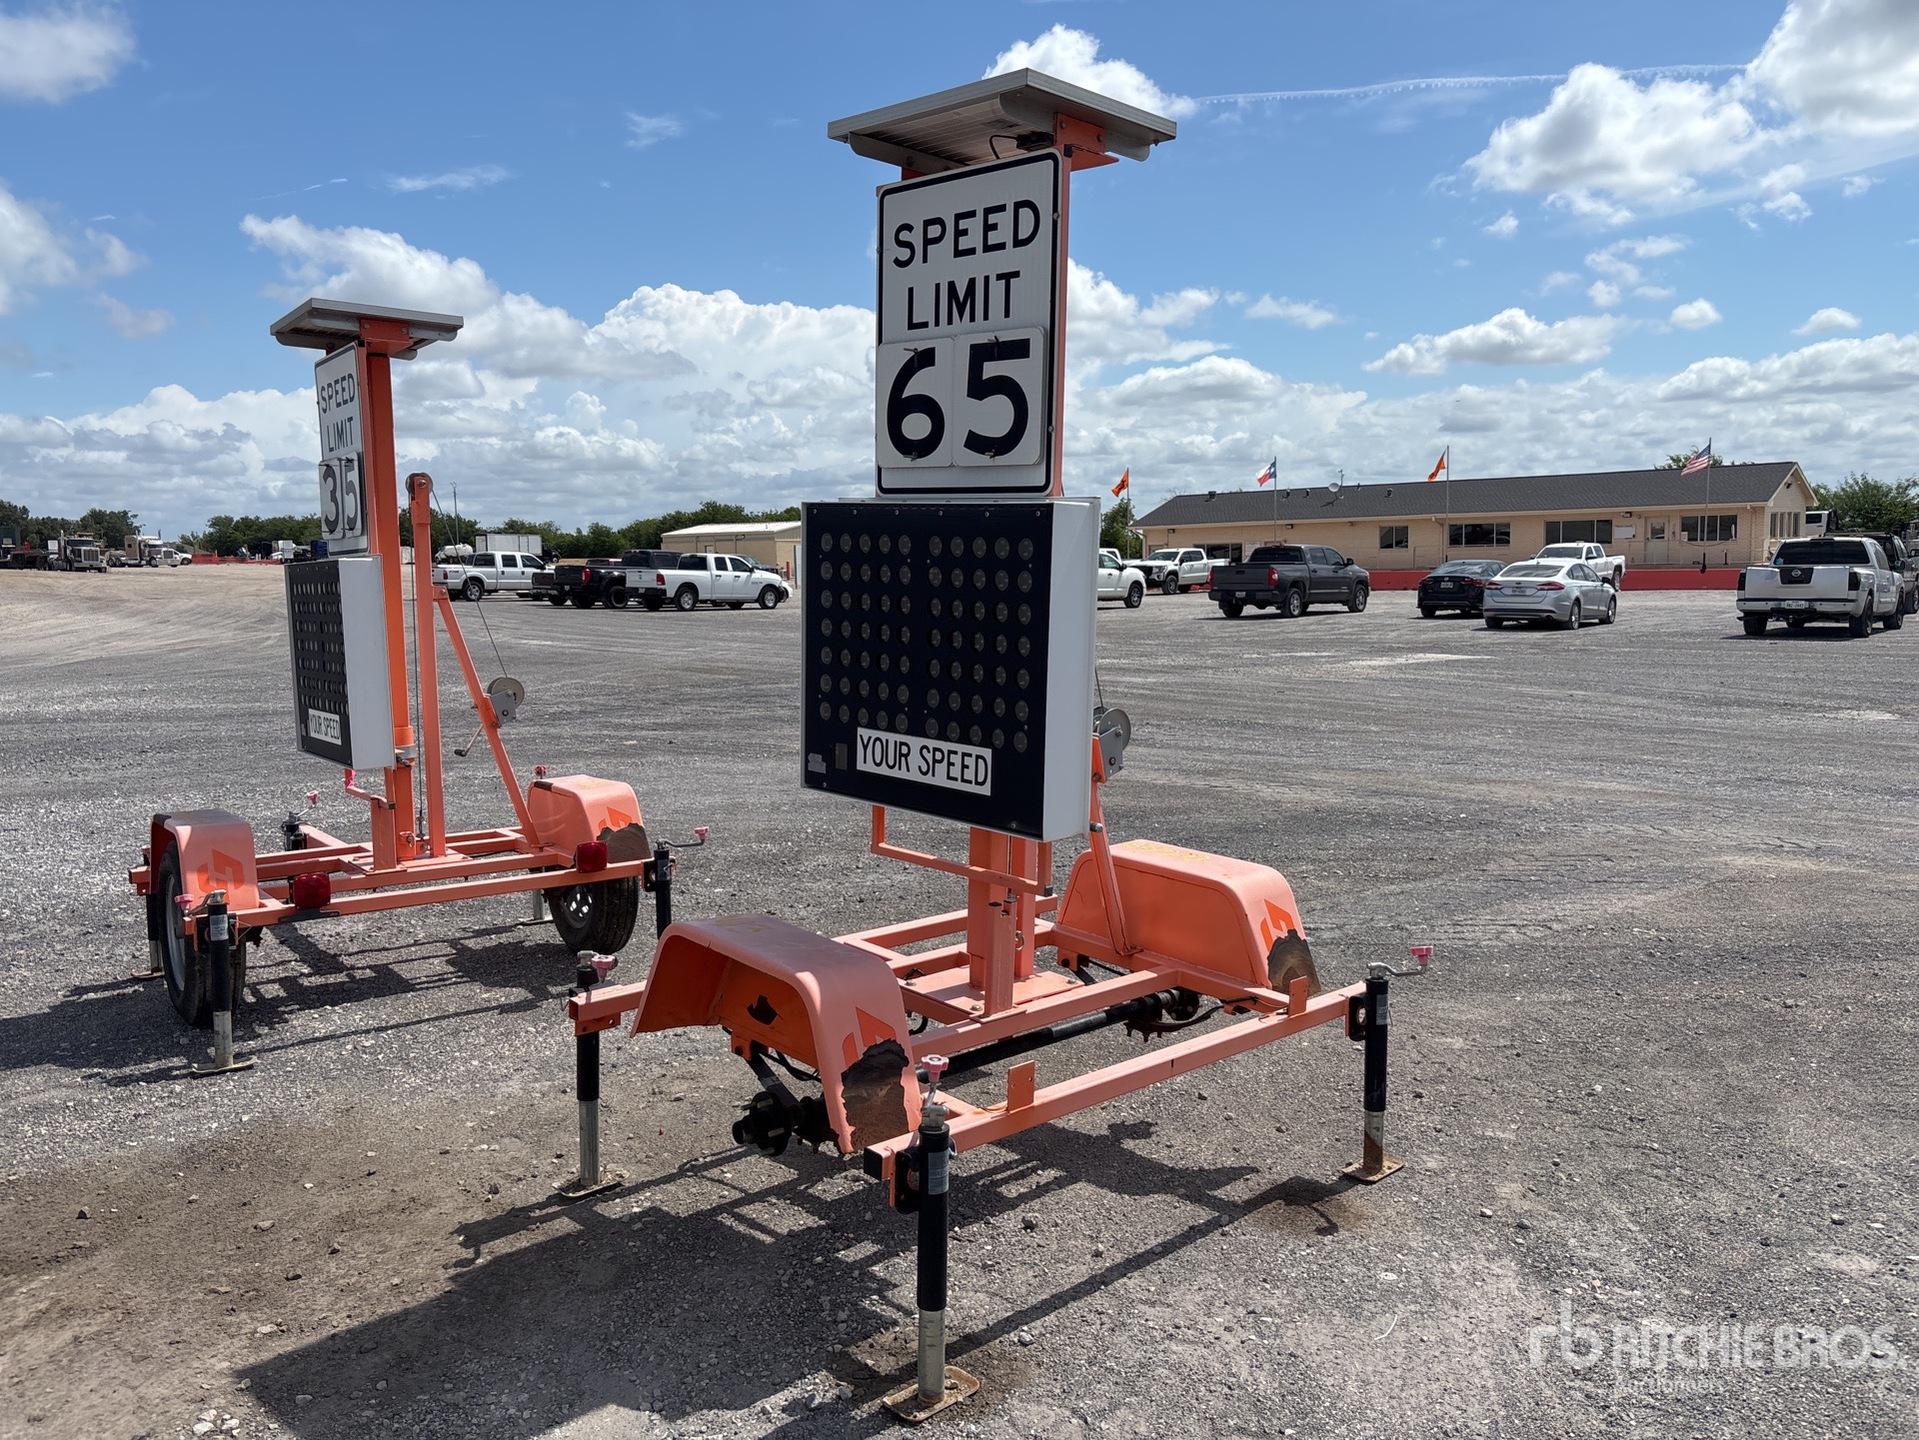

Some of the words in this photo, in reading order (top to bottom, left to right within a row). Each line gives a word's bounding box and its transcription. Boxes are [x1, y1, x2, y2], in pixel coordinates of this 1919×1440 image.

[892, 199, 1041, 269] SPEED
[907, 270, 1021, 331] LIMIT
[321, 373, 356, 414] SPEED
[887, 338, 1031, 461] 65
[327, 417, 354, 453] LIMIT
[324, 465, 358, 532] 35
[310, 714, 323, 735] YOUR
[323, 717, 340, 740] SPEED
[859, 734, 911, 772] YOUR
[918, 744, 988, 787] SPEED
